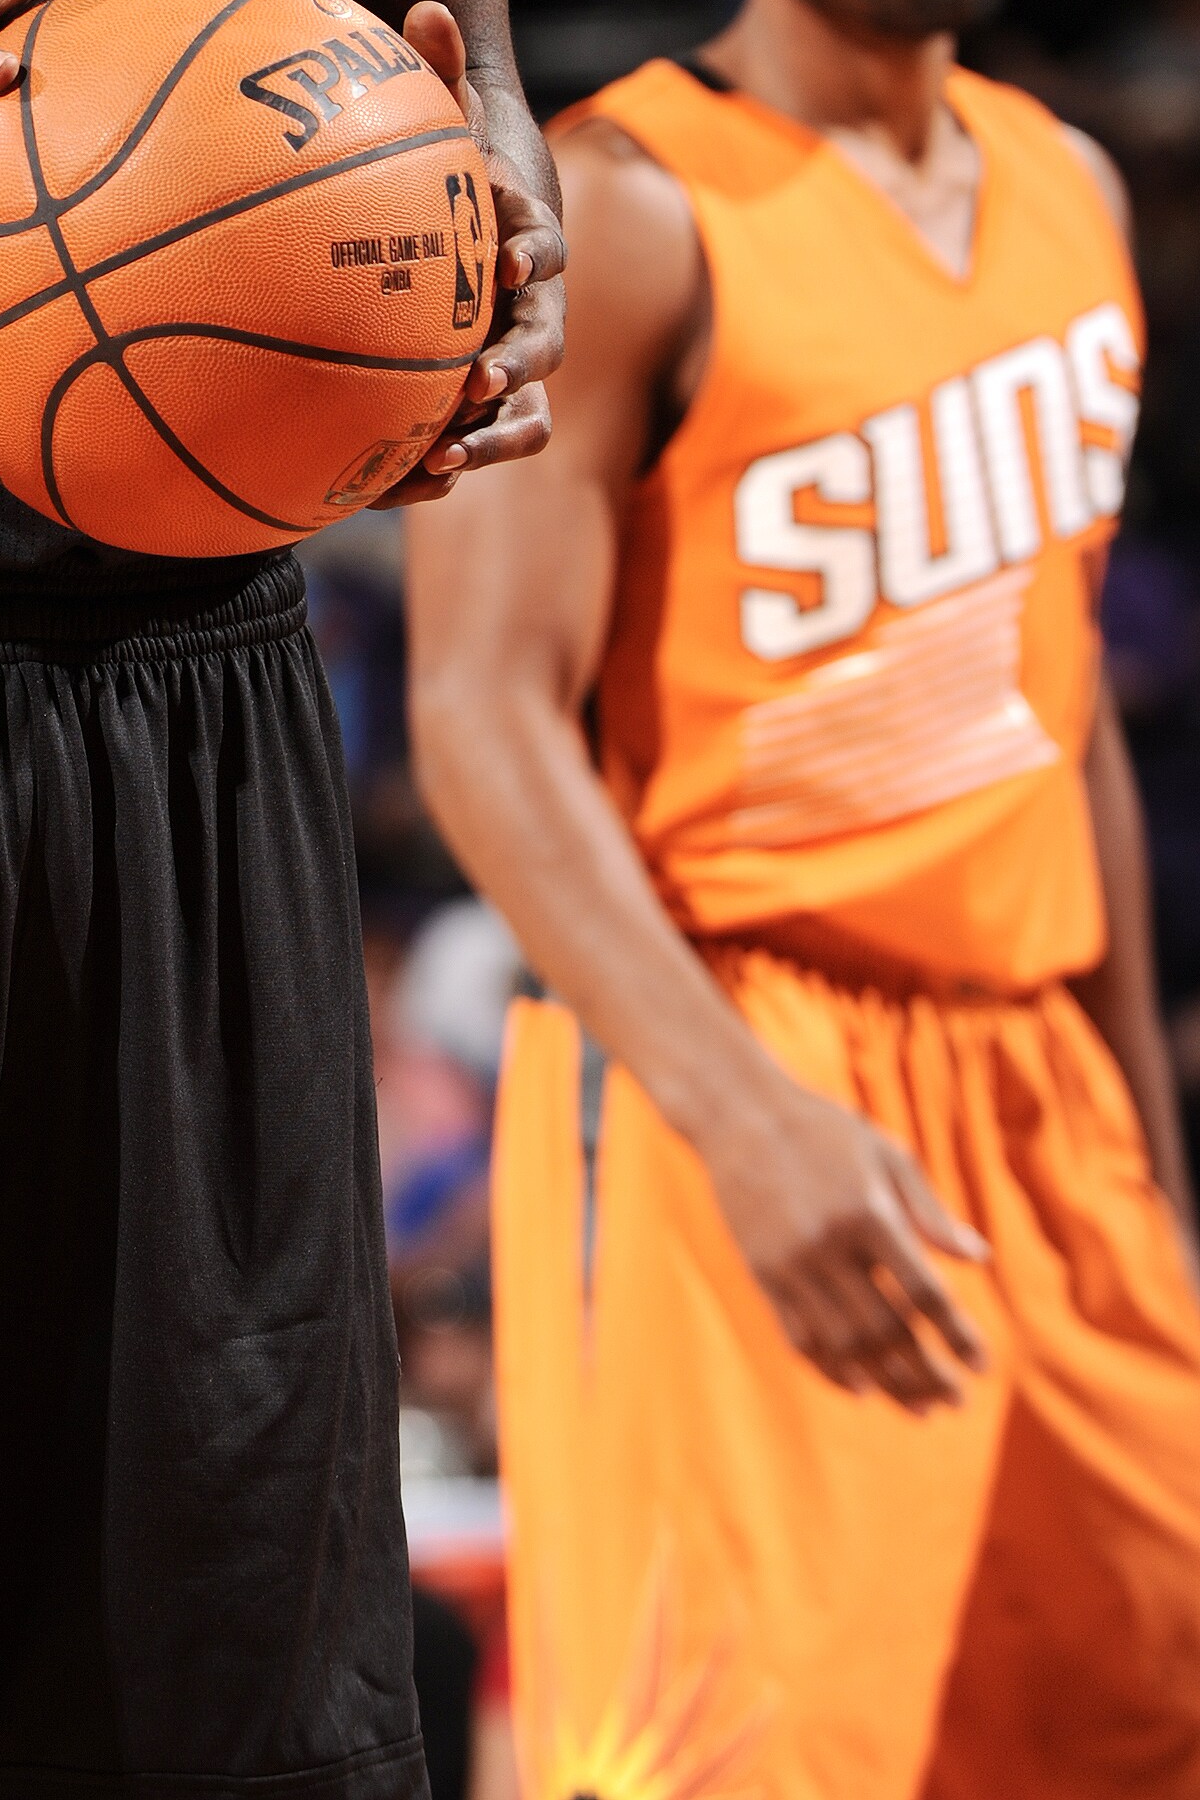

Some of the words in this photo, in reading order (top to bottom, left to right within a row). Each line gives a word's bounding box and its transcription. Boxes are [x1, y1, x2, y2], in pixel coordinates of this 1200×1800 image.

[239, 26, 438, 153] SPALD
[331, 238, 386, 269] OFFICIAL
[388, 234, 421, 263] GAME
[422, 231, 448, 260] BALL
[733, 299, 1141, 663] SUNS
